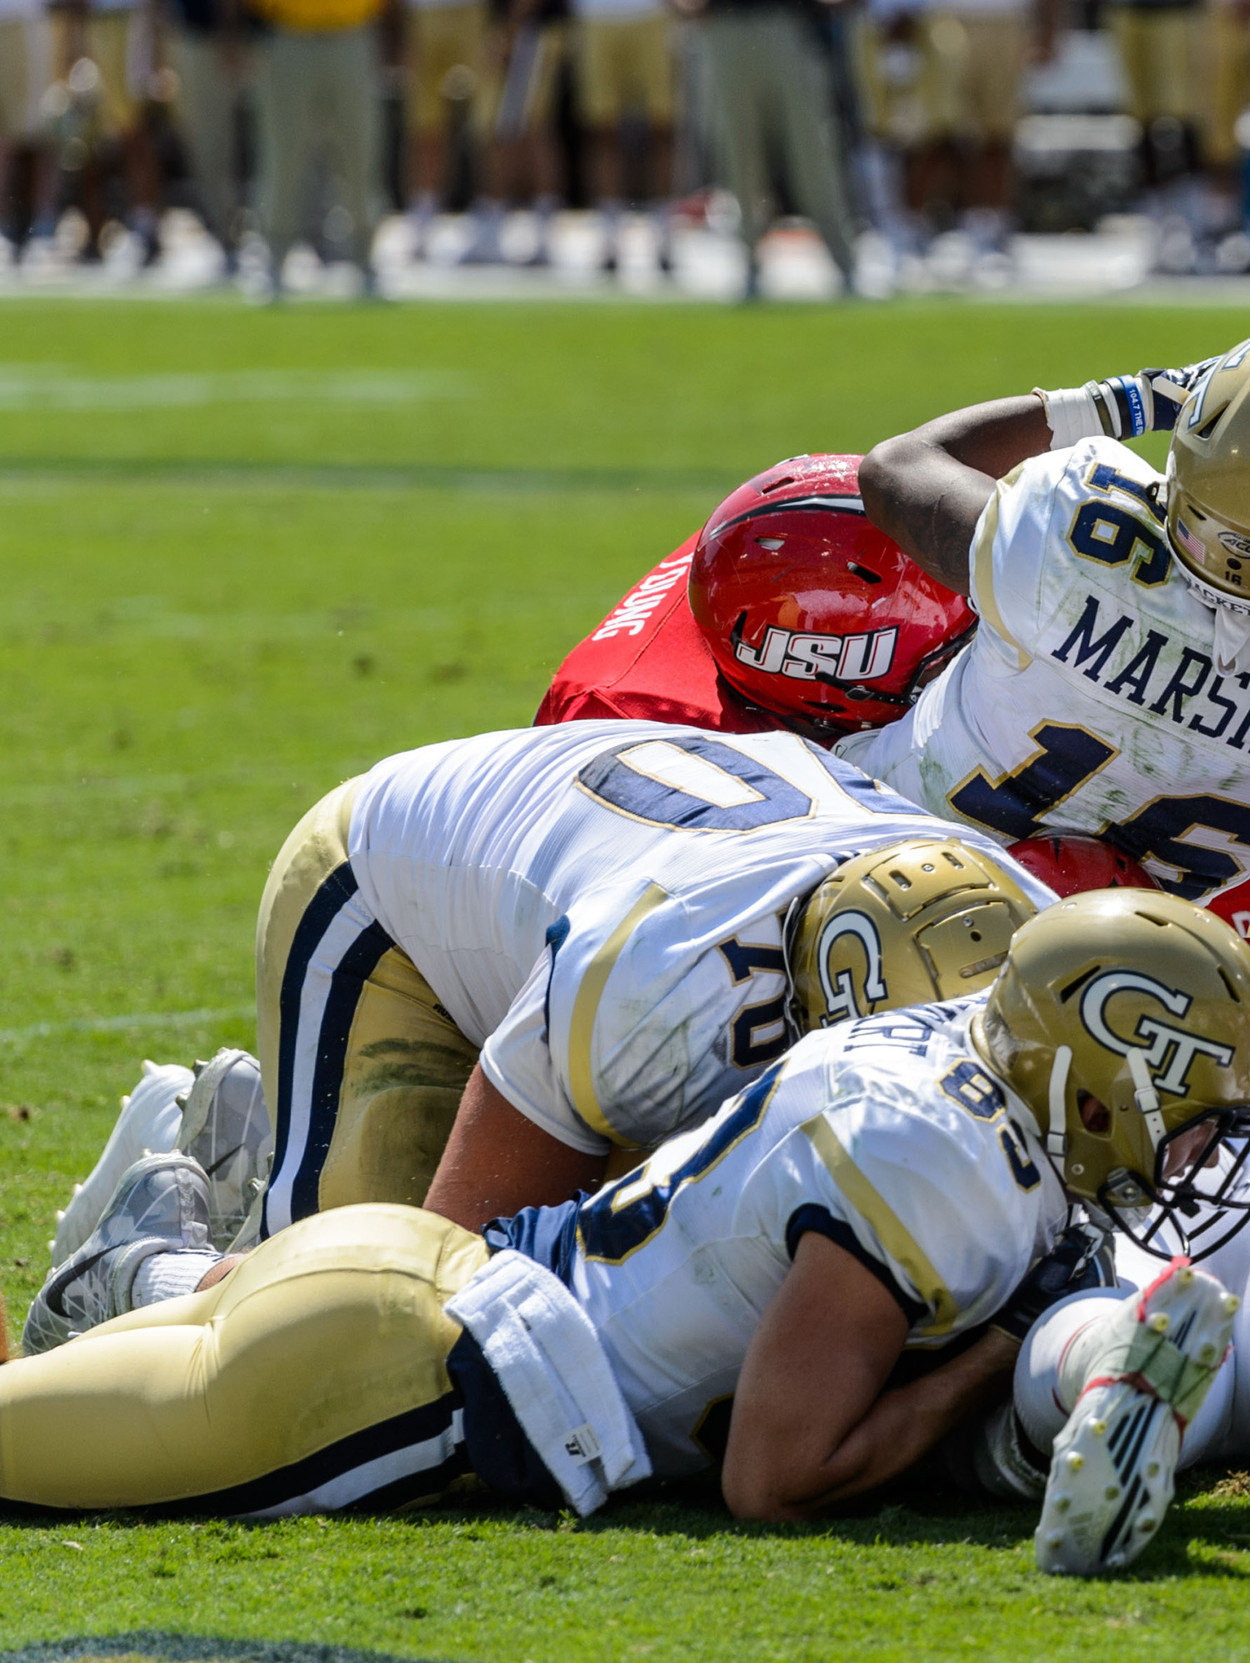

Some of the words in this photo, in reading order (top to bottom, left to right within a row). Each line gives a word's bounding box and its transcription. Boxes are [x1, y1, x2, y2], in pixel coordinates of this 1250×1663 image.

[1129, 389, 1140, 409] 104.7
[1134, 411, 1143, 426] THE
[1066, 461, 1174, 590] 16
[1224, 570, 1243, 587] 16
[734, 624, 900, 682] JSU
[1079, 969, 1236, 1098] GT
